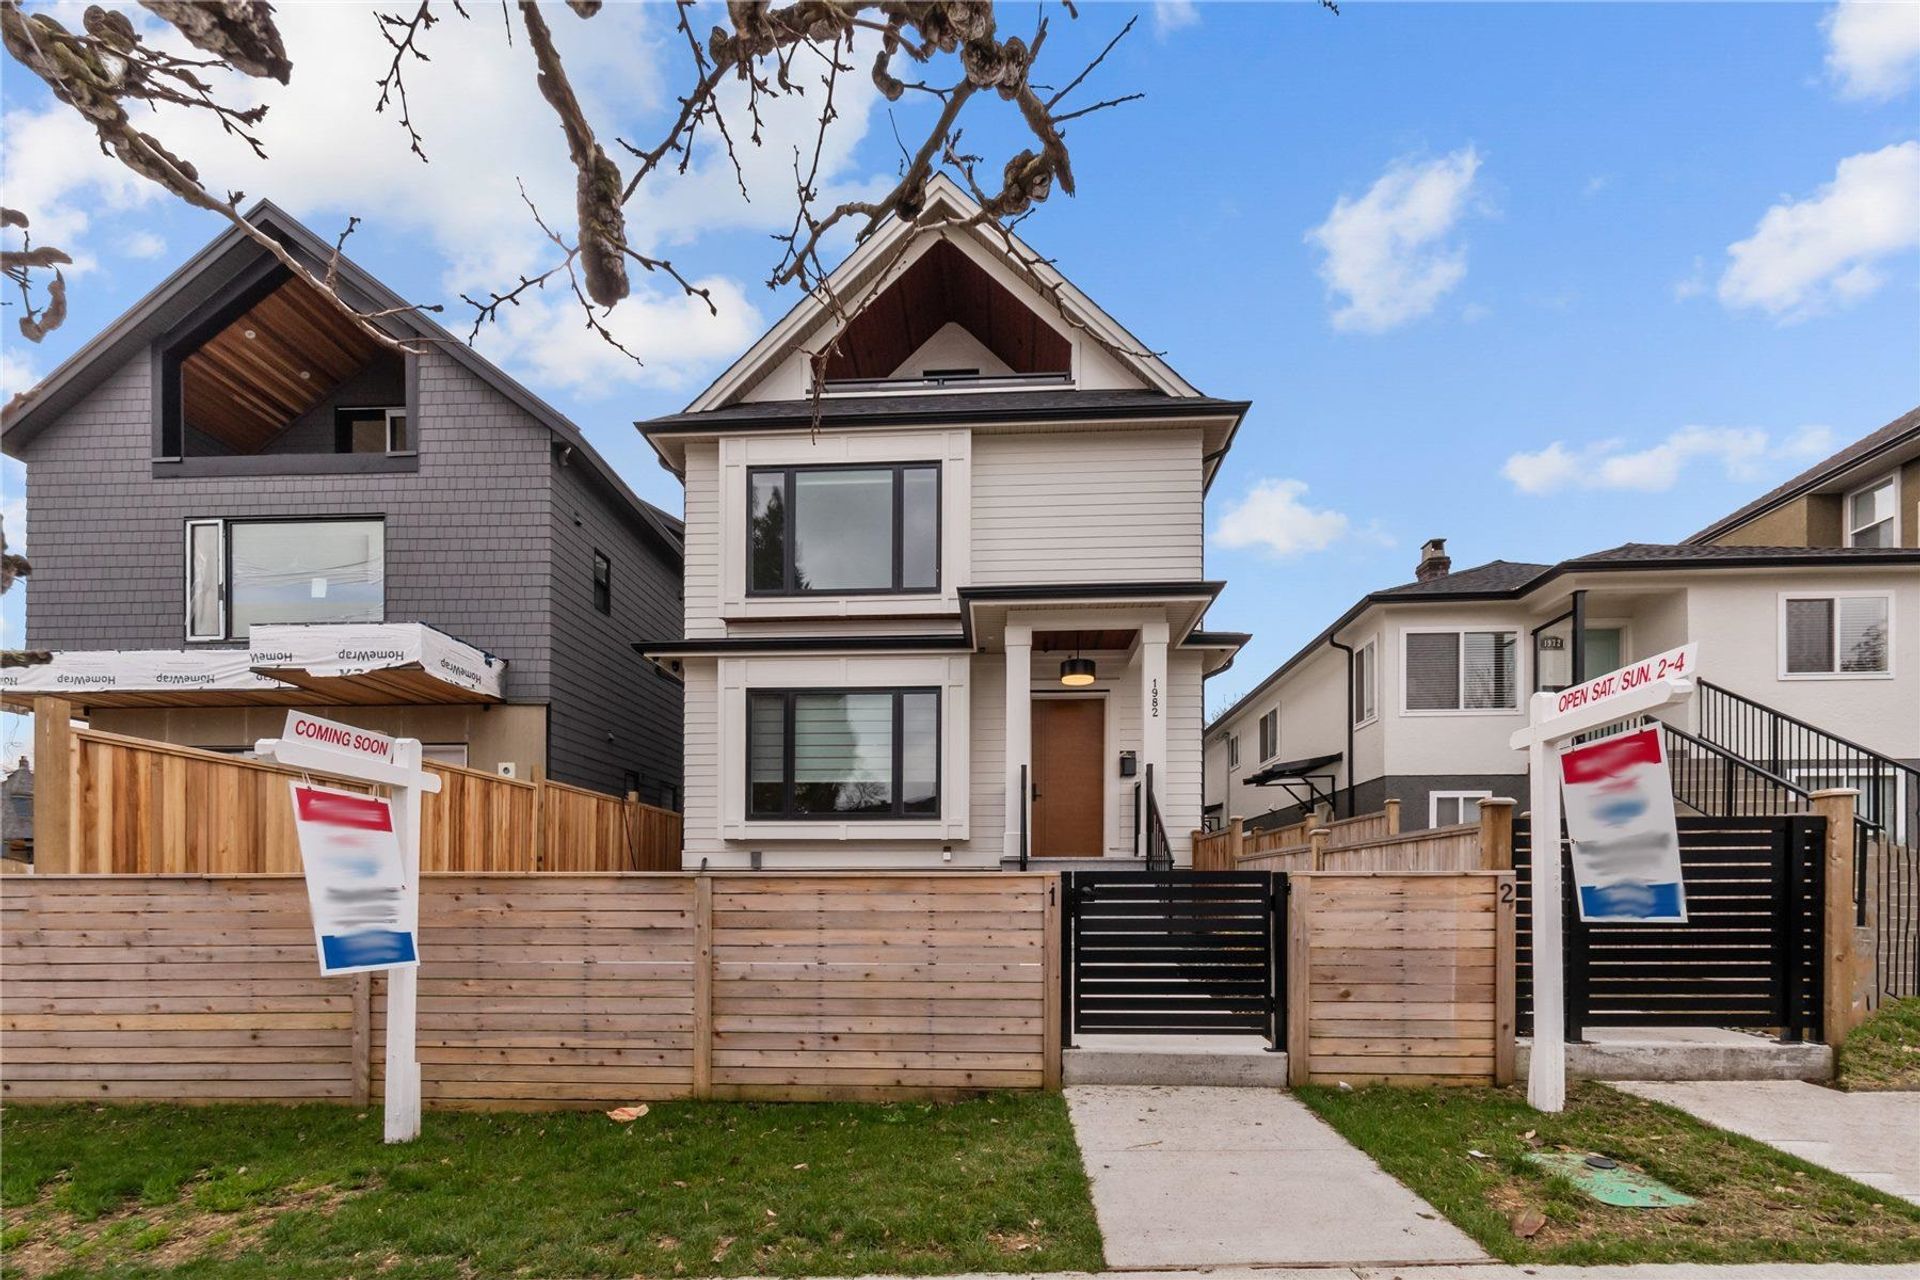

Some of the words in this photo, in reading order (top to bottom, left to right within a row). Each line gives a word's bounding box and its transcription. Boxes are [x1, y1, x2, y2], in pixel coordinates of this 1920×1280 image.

[250, 652, 293, 662] HomeW
[338, 649, 404, 662] HomeWrap
[57, 675, 116, 685] HomeWrap
[156, 673, 215, 684] HomeWrap
[440, 658, 482, 684] HomeWrap
[1559, 685, 1589, 712] OPEN
[1657, 652, 1685, 679] 2-4
[1151, 678, 1159, 718] 1982
[295, 719, 351, 747] COMING
[353, 735, 389, 755] SOON
[1049, 886, 1055, 907] 1
[1500, 883, 1515, 904] 2
